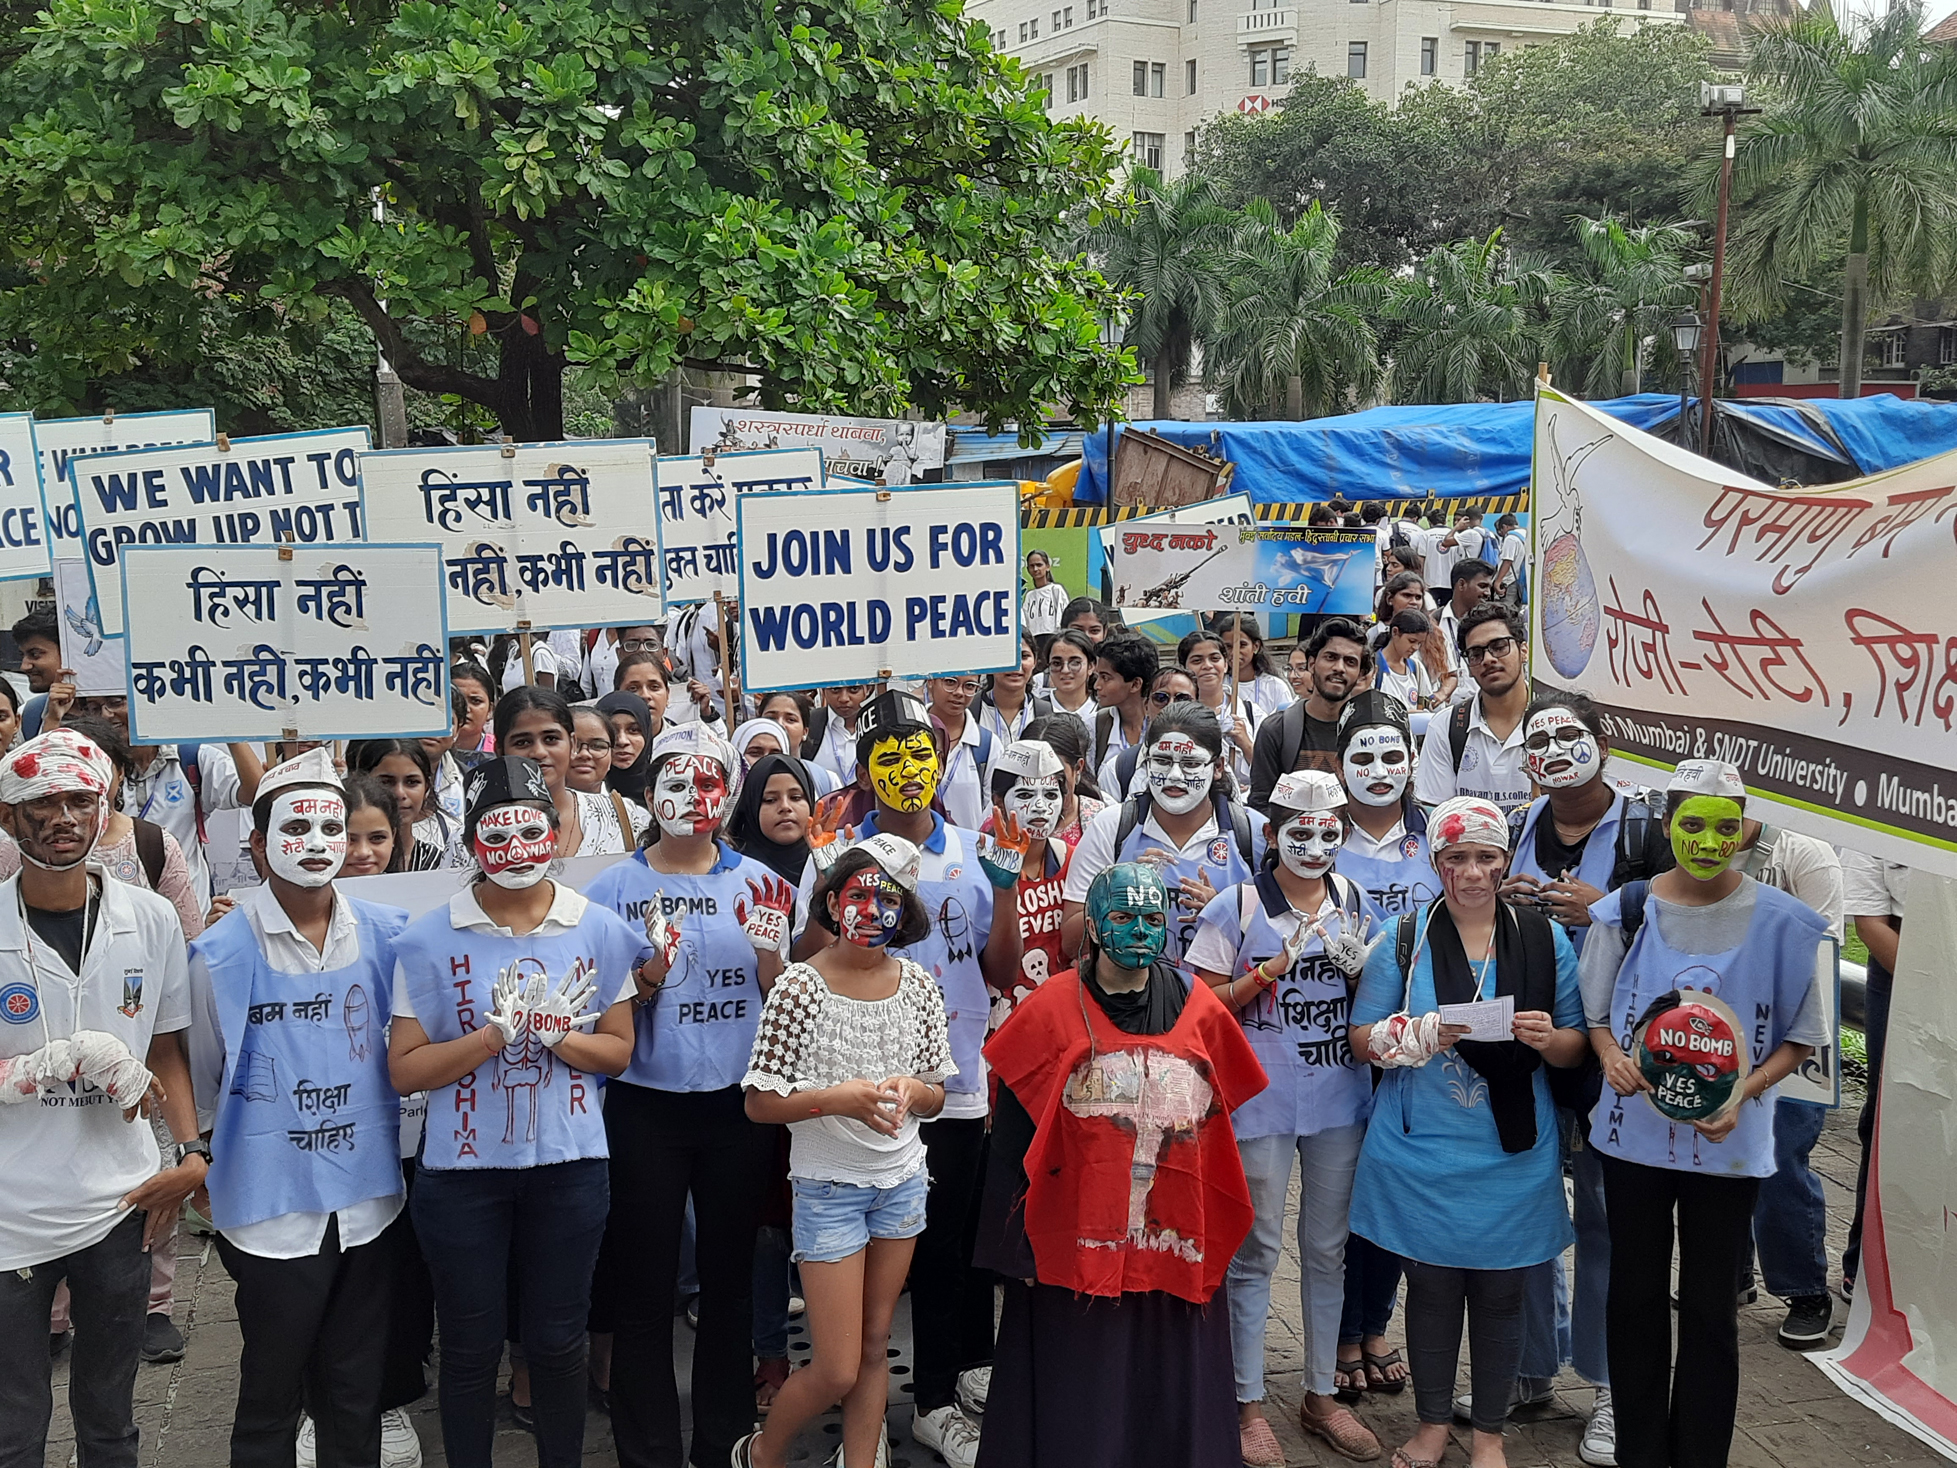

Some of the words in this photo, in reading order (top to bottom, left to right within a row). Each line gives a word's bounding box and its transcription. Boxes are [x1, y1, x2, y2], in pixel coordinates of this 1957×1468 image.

[91, 470, 169, 514] WE
[180, 456, 296, 504] WANT
[307, 448, 357, 490] TO
[418, 468, 513, 532] हिंसा
[522, 464, 590, 528] नहीं
[269, 503, 335, 543] NOT
[752, 529, 852, 579] JOIN
[866, 525, 914, 573] US
[929, 522, 1004, 569] FOR
[1169, 529, 1217, 550] नको
[1696, 486, 1873, 595] परमाणु
[516, 540, 586, 594] कभी
[592, 538, 655, 594] नहीं
[185, 566, 281, 629] हिंसा
[294, 564, 367, 628] नहीं
[1219, 581, 1271, 605] शांती
[1271, 584, 1312, 606] हवी
[749, 599, 892, 652] WORLD
[905, 590, 1010, 641] PEACE
[132, 645, 216, 704] कभी
[294, 645, 378, 702] कभी
[382, 644, 444, 706] नहीं
[1531, 717, 1545, 731] YES
[1548, 715, 1577, 726] PEACE
[1360, 736, 1374, 747] NO
[665, 757, 719, 779] PEACE
[1600, 713, 1618, 737] of
[1615, 716, 1690, 755] Mumbai
[1693, 727, 1708, 759] &
[1709, 732, 1758, 771] SNDT
[1757, 743, 1847, 805] University
[1357, 768, 1370, 778] NO
[1386, 767, 1406, 776] WAR
[290, 799, 318, 815] बम
[656, 799, 677, 822] NO
[480, 810, 512, 831] MAKE
[514, 808, 543, 824] LOVE
[281, 838, 305, 855] रोटी
[486, 850, 506, 865] NO
[526, 841, 551, 857] WAR
[1681, 839, 1700, 856] NO
[857, 873, 880, 887] YES
[661, 897, 717, 916] BOMB
[1127, 885, 1162, 909] NO
[758, 909, 781, 927] YES
[747, 923, 780, 943] PEACE
[1341, 942, 1357, 960] YES
[706, 967, 745, 987] YES
[249, 1002, 287, 1025] बम
[292, 992, 333, 1028] नहीं
[679, 1000, 747, 1024] PEACE
[533, 1012, 571, 1033] BOMB
[1659, 1028, 1686, 1047] NO
[1689, 1034, 1733, 1057] BOMB
[1665, 1073, 1696, 1092] YES
[41, 1096, 66, 1107] NOT
[293, 1079, 351, 1116] शिक्षा
[1657, 1086, 1702, 1109] PEACE
[288, 1119, 356, 1155] चाहिए
